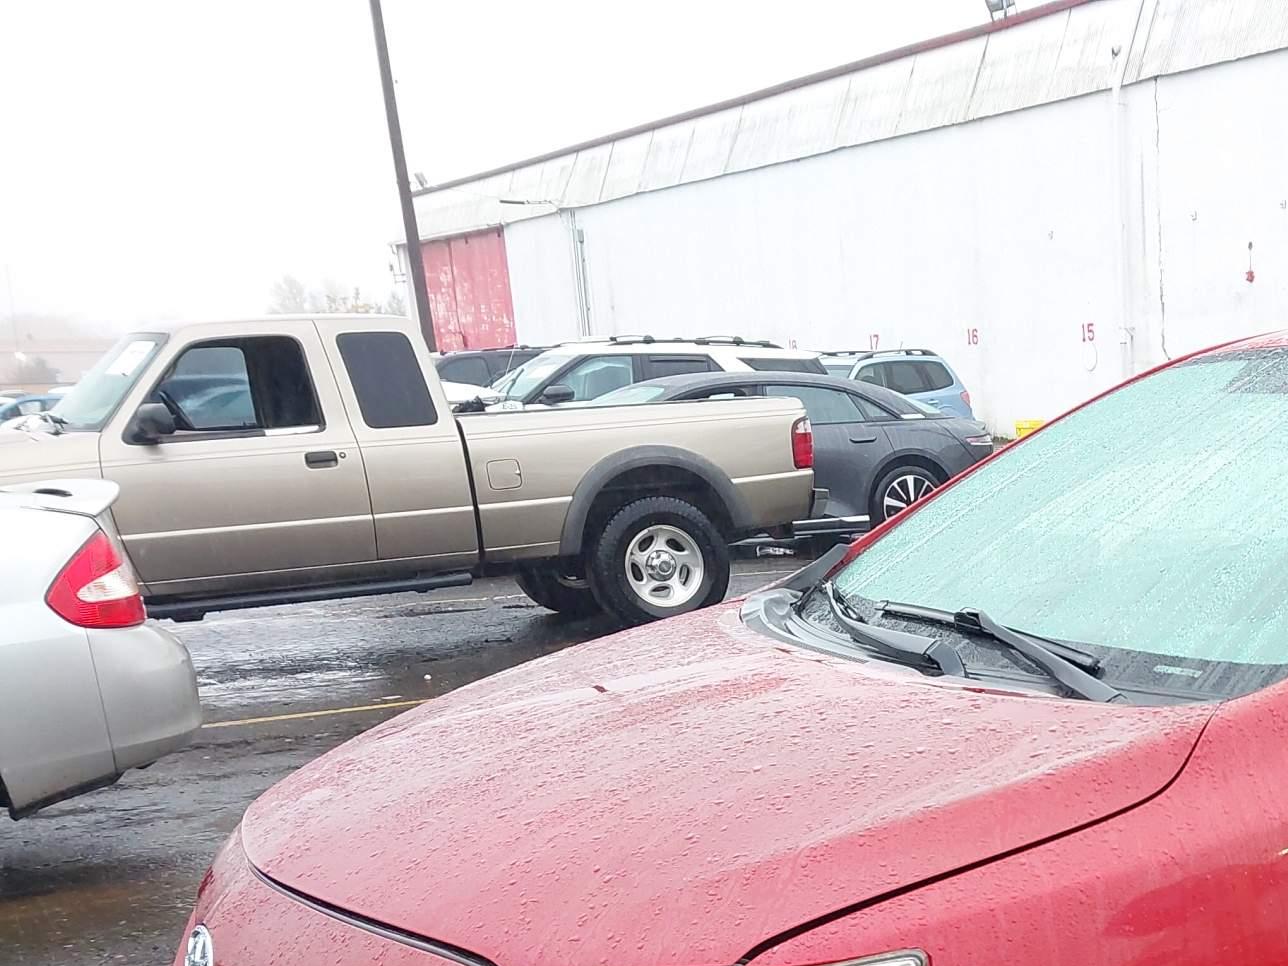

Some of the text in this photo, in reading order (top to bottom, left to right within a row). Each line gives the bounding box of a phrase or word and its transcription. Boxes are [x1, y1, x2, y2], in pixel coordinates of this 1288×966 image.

[967, 328, 979, 345] 16
[1081, 323, 1095, 342] 15
[869, 334, 879, 350] 17
